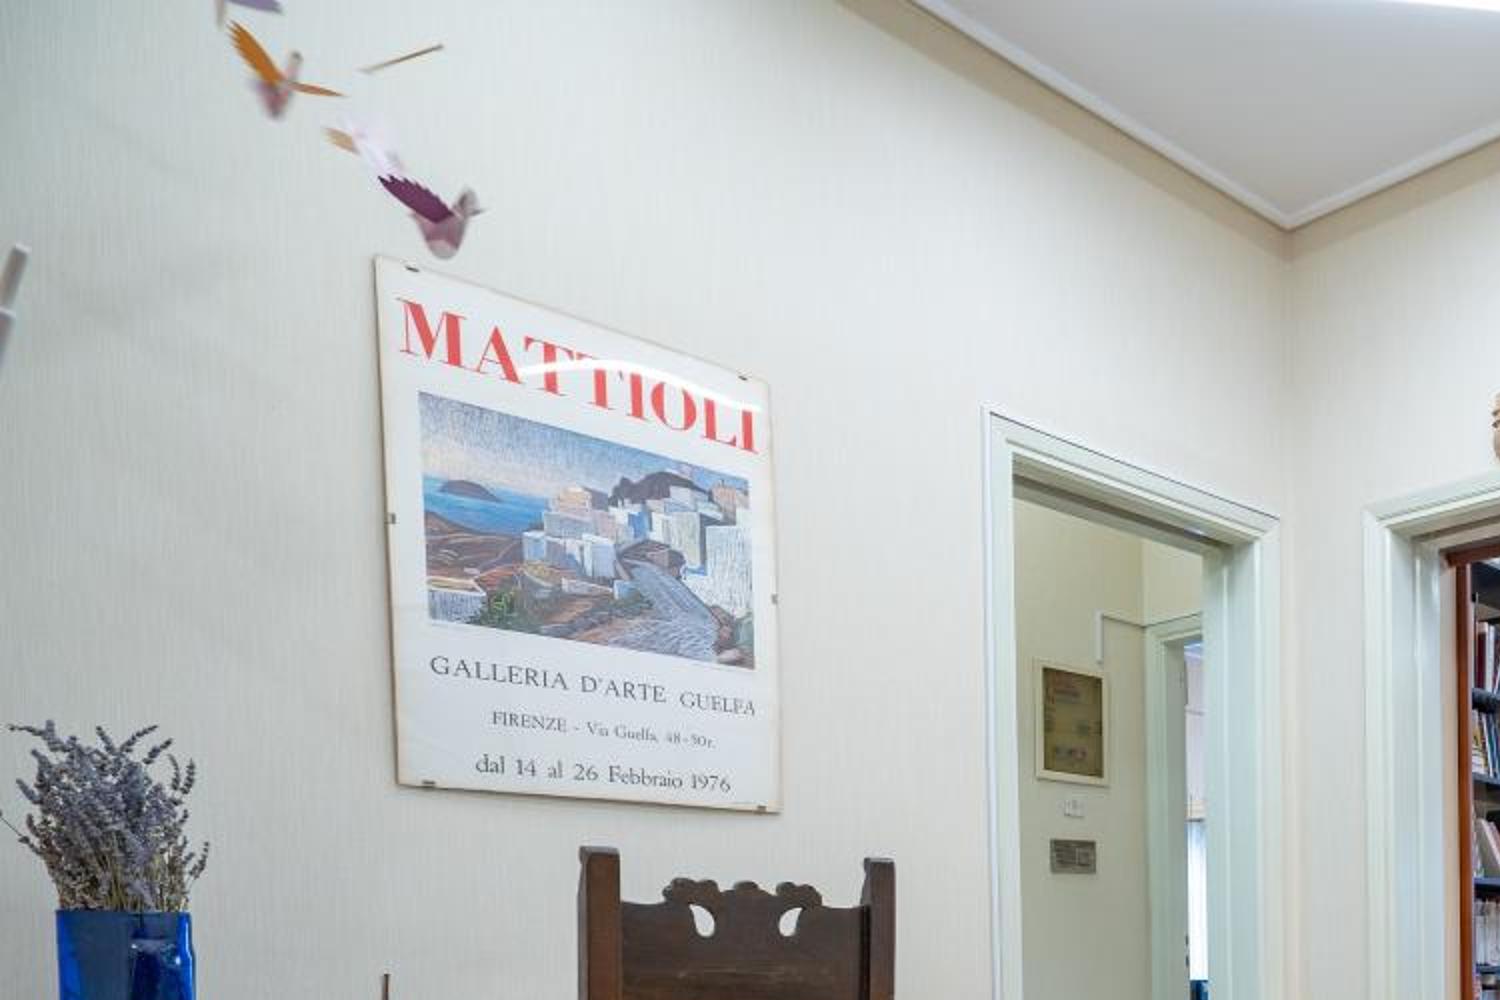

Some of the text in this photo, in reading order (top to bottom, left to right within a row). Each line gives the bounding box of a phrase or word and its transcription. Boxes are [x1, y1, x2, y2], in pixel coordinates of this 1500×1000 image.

[397, 298, 759, 454] MATTIOLI
[430, 656, 756, 716] GALLERIA D'ARTE GUELFA
[493, 711, 567, 732] FIRENZE
[587, 721, 609, 737] Via
[475, 753, 731, 793] dal 14 al 26 Febbraio 1976
